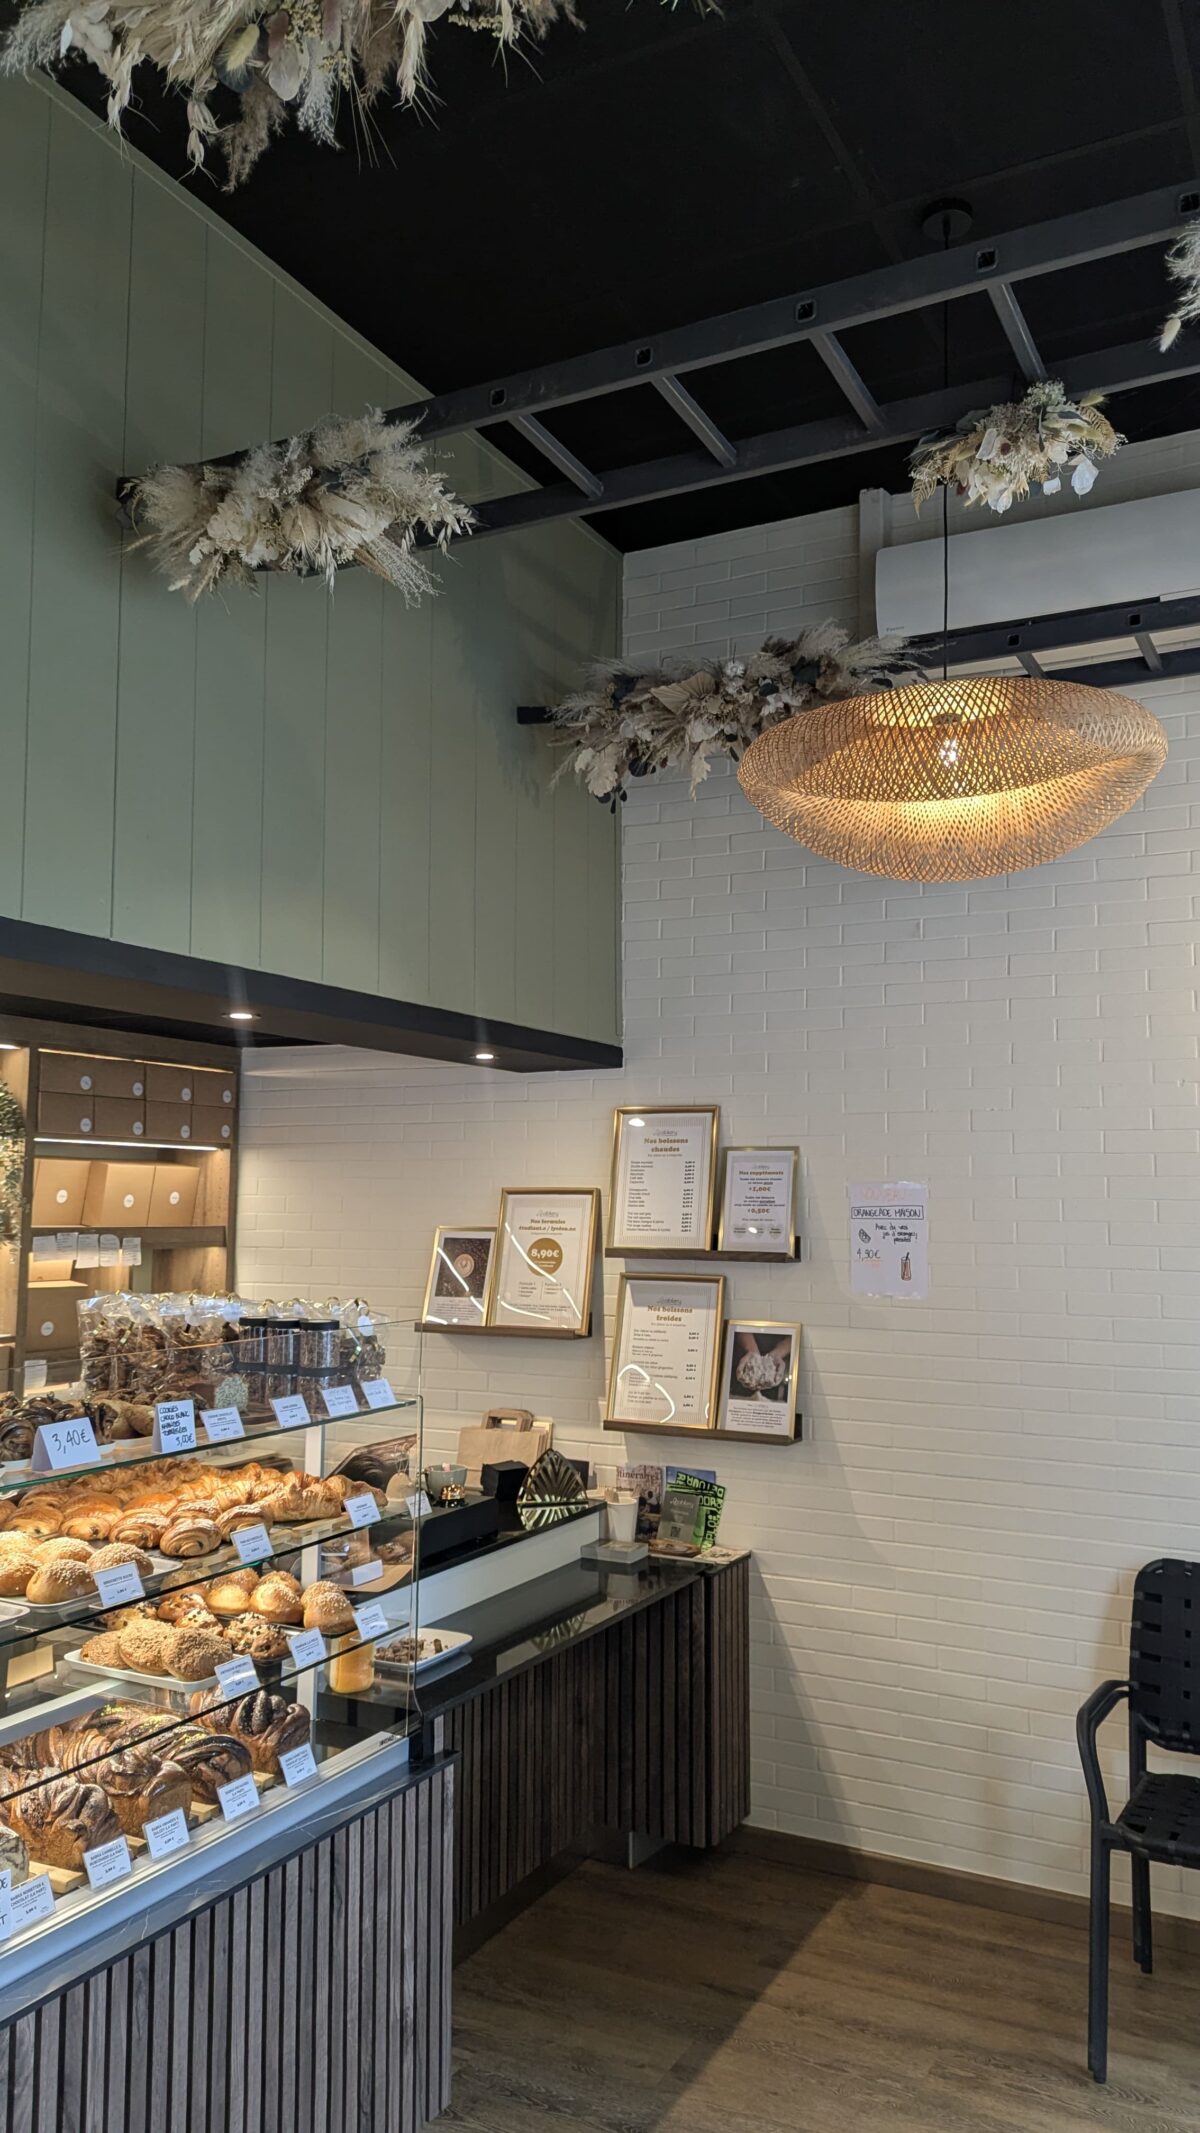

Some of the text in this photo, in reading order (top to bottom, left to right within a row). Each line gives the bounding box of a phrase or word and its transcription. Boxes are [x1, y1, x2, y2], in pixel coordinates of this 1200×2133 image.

[853, 1207, 921, 1218] ORANGEADE MAISON
[531, 1249, 560, 1259] 8,90€
[662, 1306, 693, 1314] boissons
[656, 1314, 682, 1322] froides
[51, 1428, 91, 1455] 3,40€
